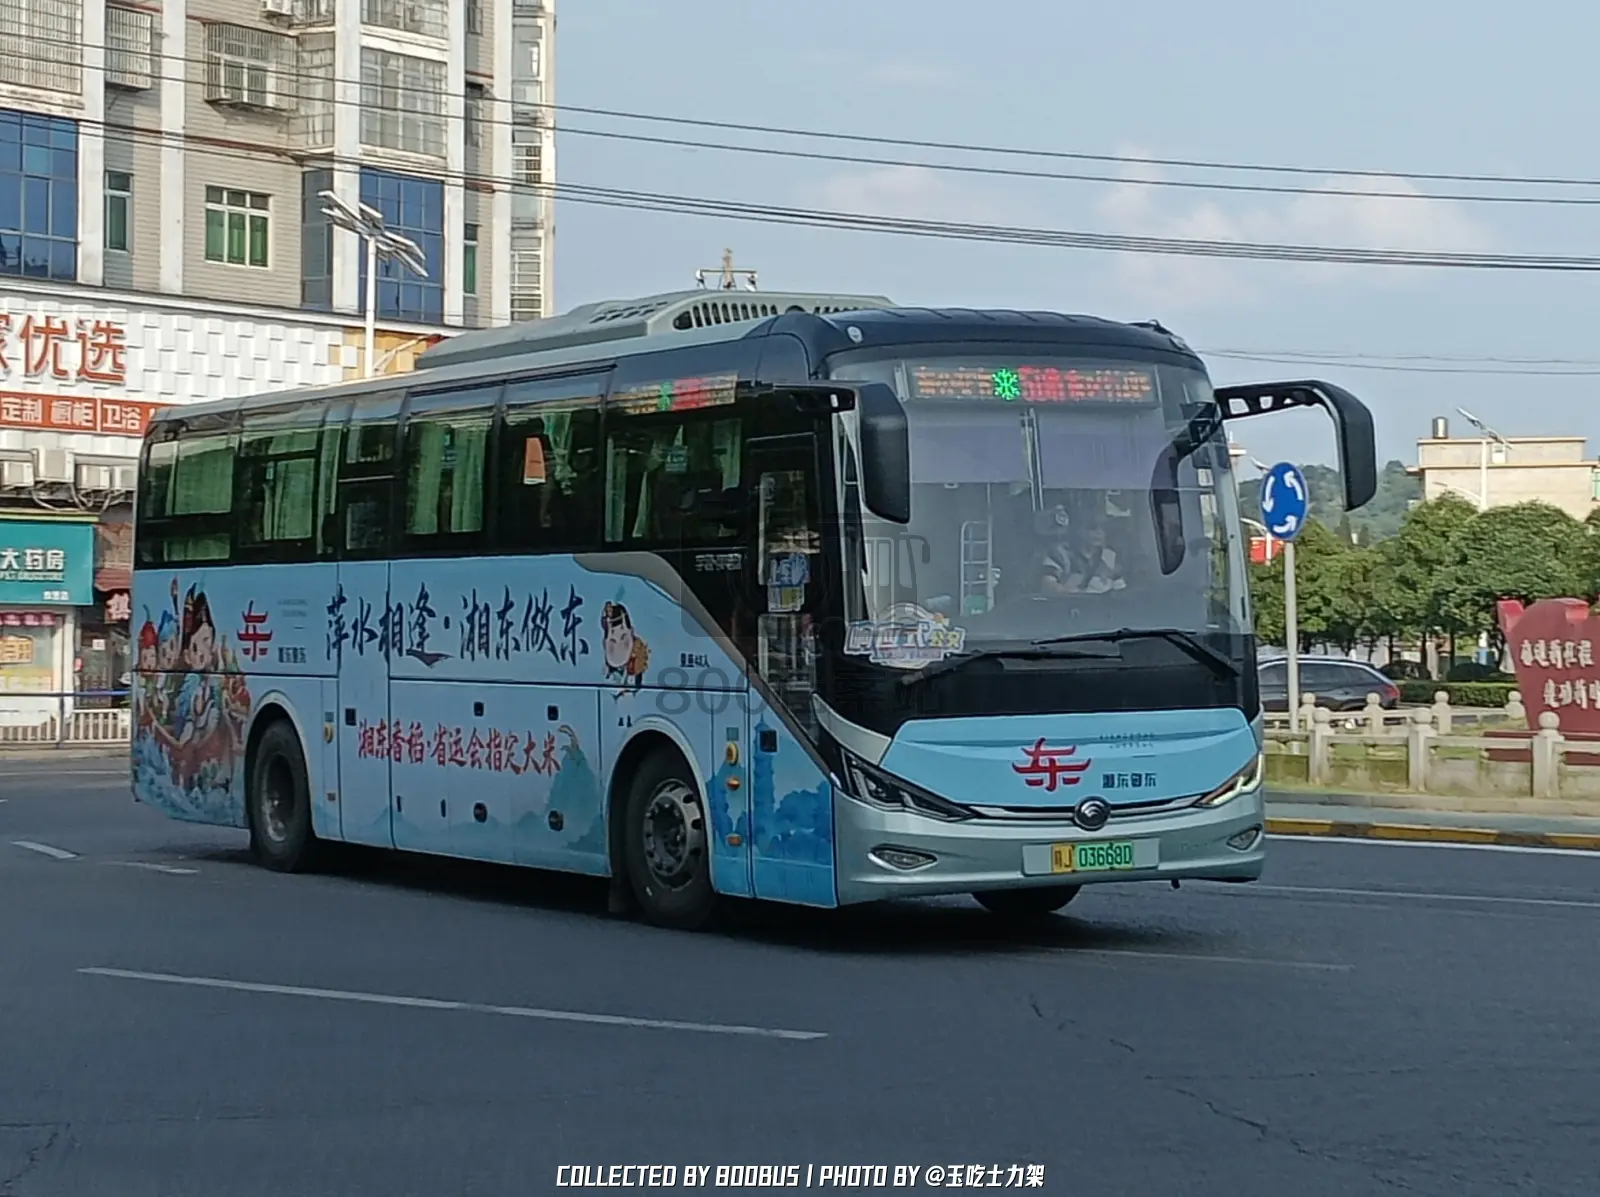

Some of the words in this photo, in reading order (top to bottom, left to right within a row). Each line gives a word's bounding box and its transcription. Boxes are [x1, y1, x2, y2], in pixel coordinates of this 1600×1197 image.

[102, 404, 141, 430] 卫浴
[1, 548, 65, 571] 大药房
[1078, 845, 1132, 867] 03668D
